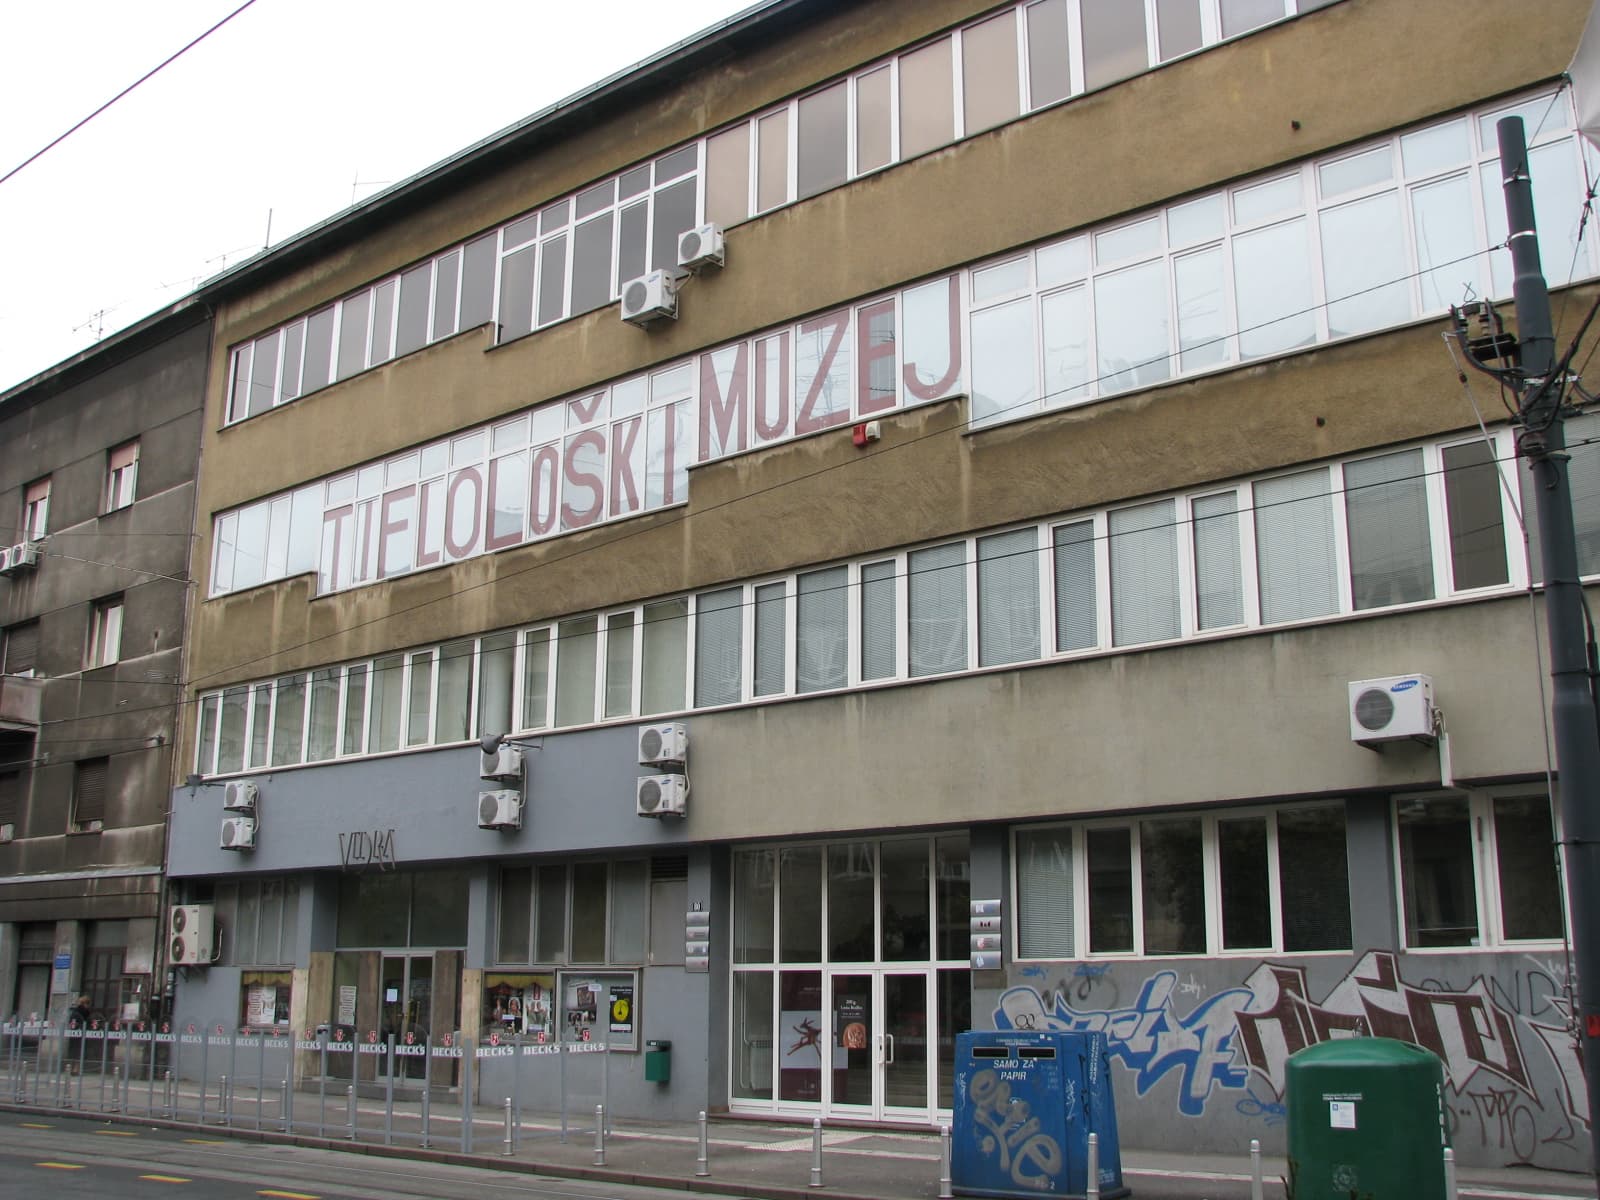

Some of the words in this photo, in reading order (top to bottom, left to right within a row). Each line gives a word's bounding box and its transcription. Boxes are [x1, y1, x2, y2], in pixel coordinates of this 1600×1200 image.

[323, 391, 675, 592] TIFLOLOŠKI
[697, 273, 962, 462] MUZEJ
[338, 828, 396, 872] VIDRA
[993, 1060, 1019, 1069] SAMO
[1022, 1060, 1034, 1069] ZA
[1001, 1071, 1027, 1080] PAPIR
